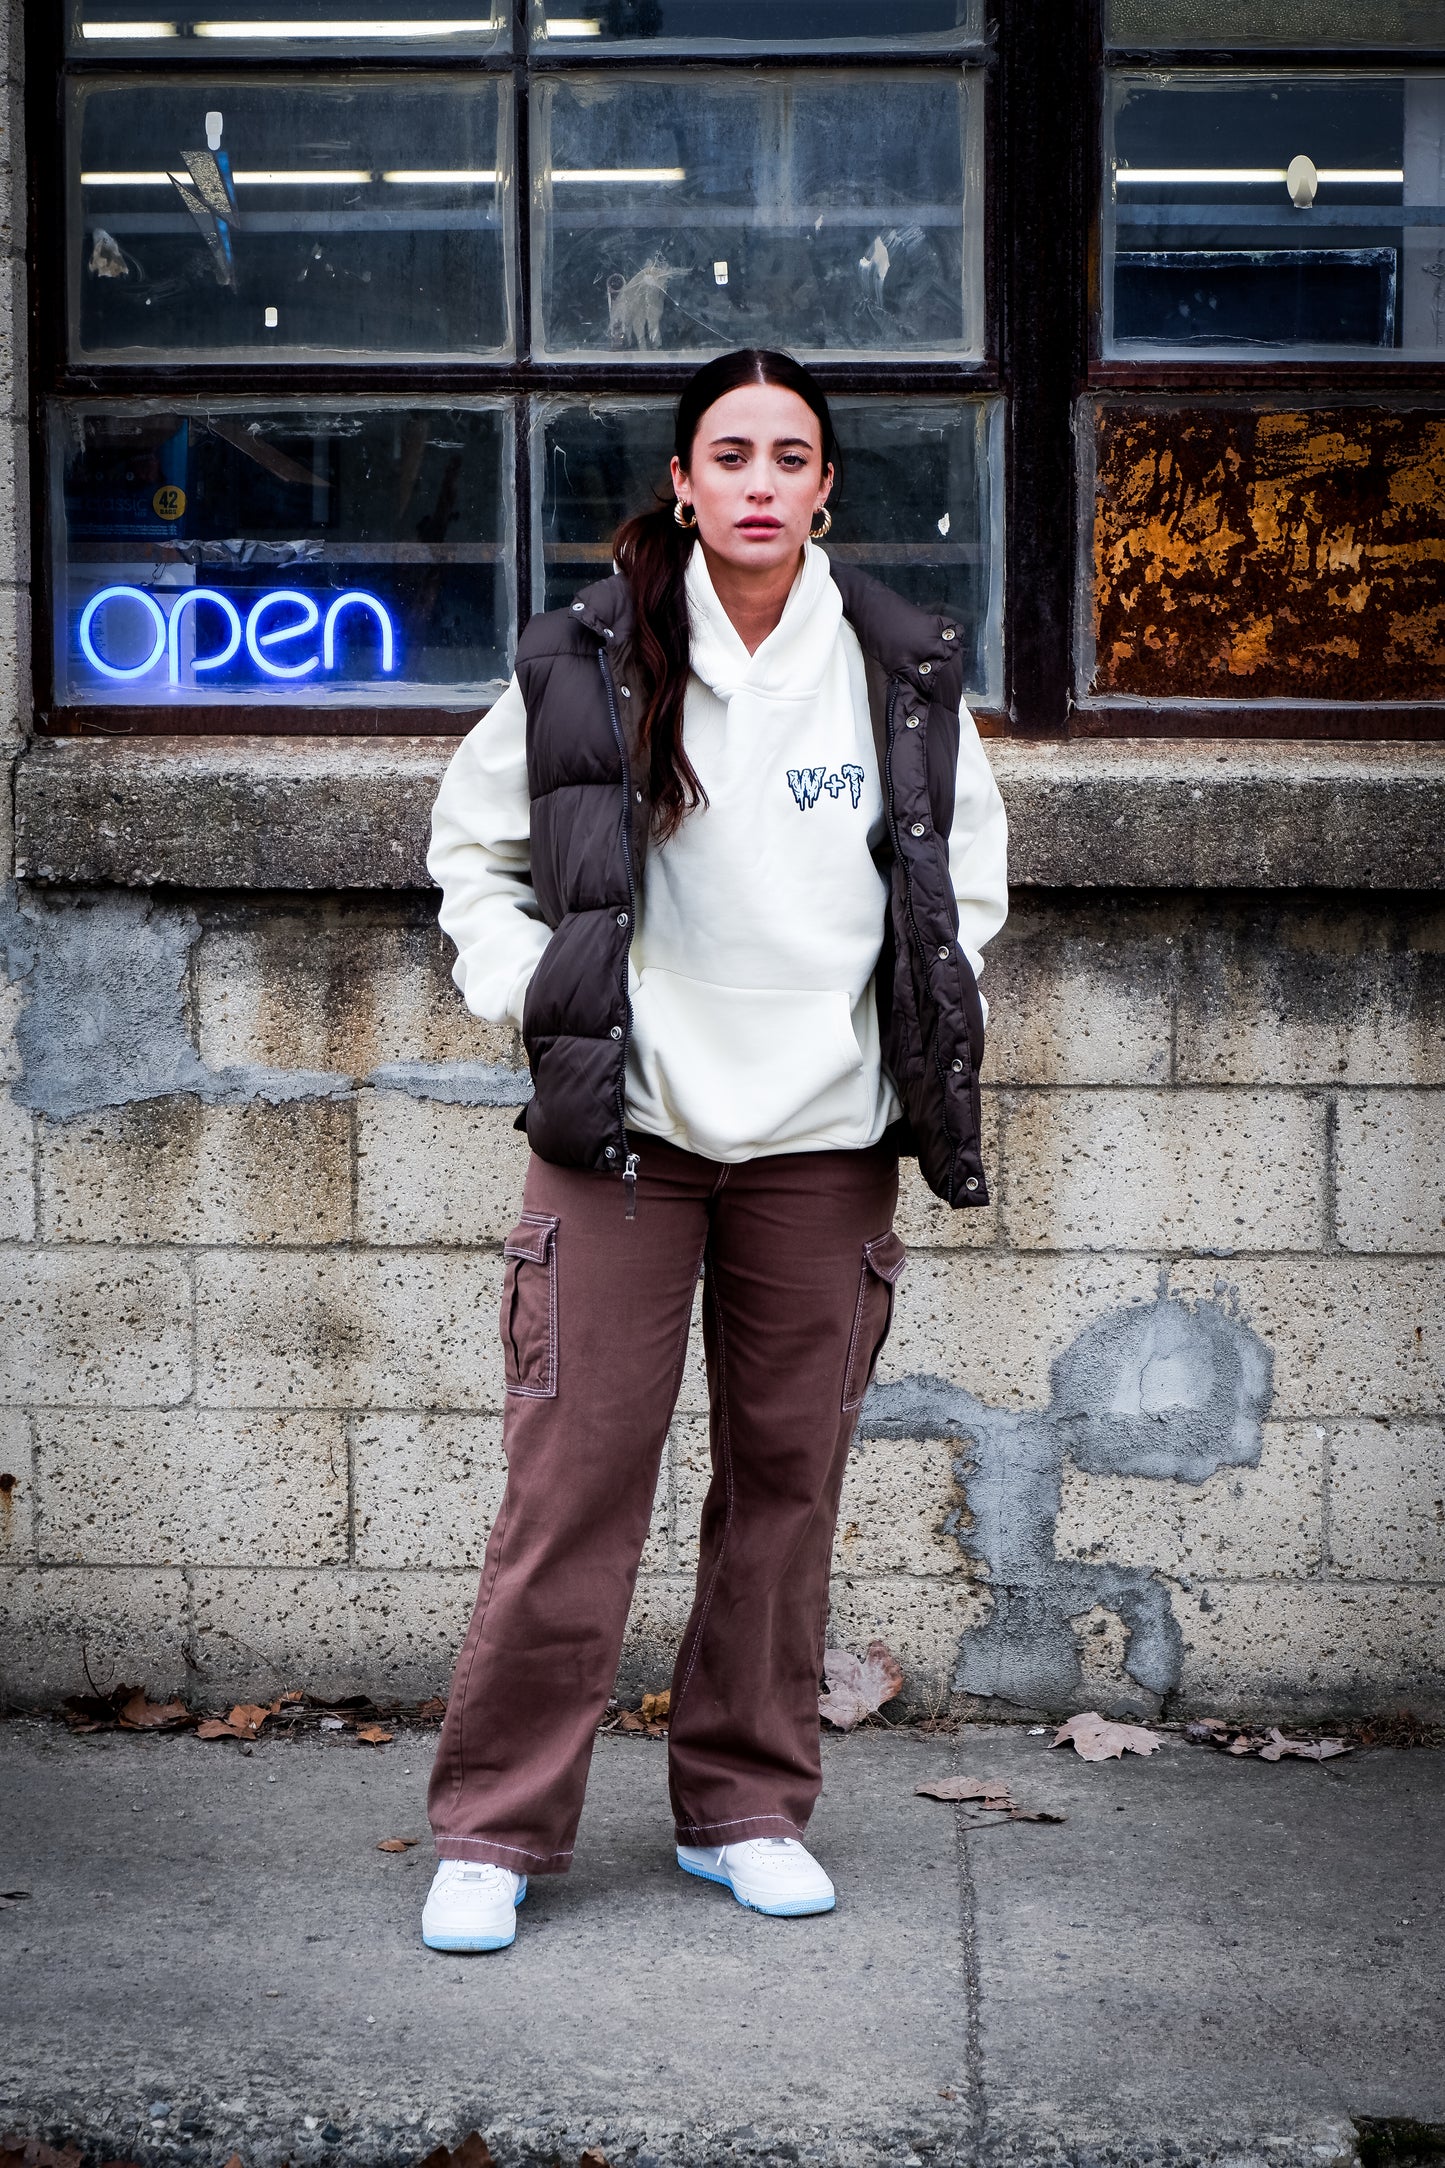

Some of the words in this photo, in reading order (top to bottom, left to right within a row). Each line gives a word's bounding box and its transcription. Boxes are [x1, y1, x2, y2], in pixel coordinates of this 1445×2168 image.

[159, 491, 178, 508] 42
[80, 585, 393, 686] open
[786, 764, 864, 811] W+T
